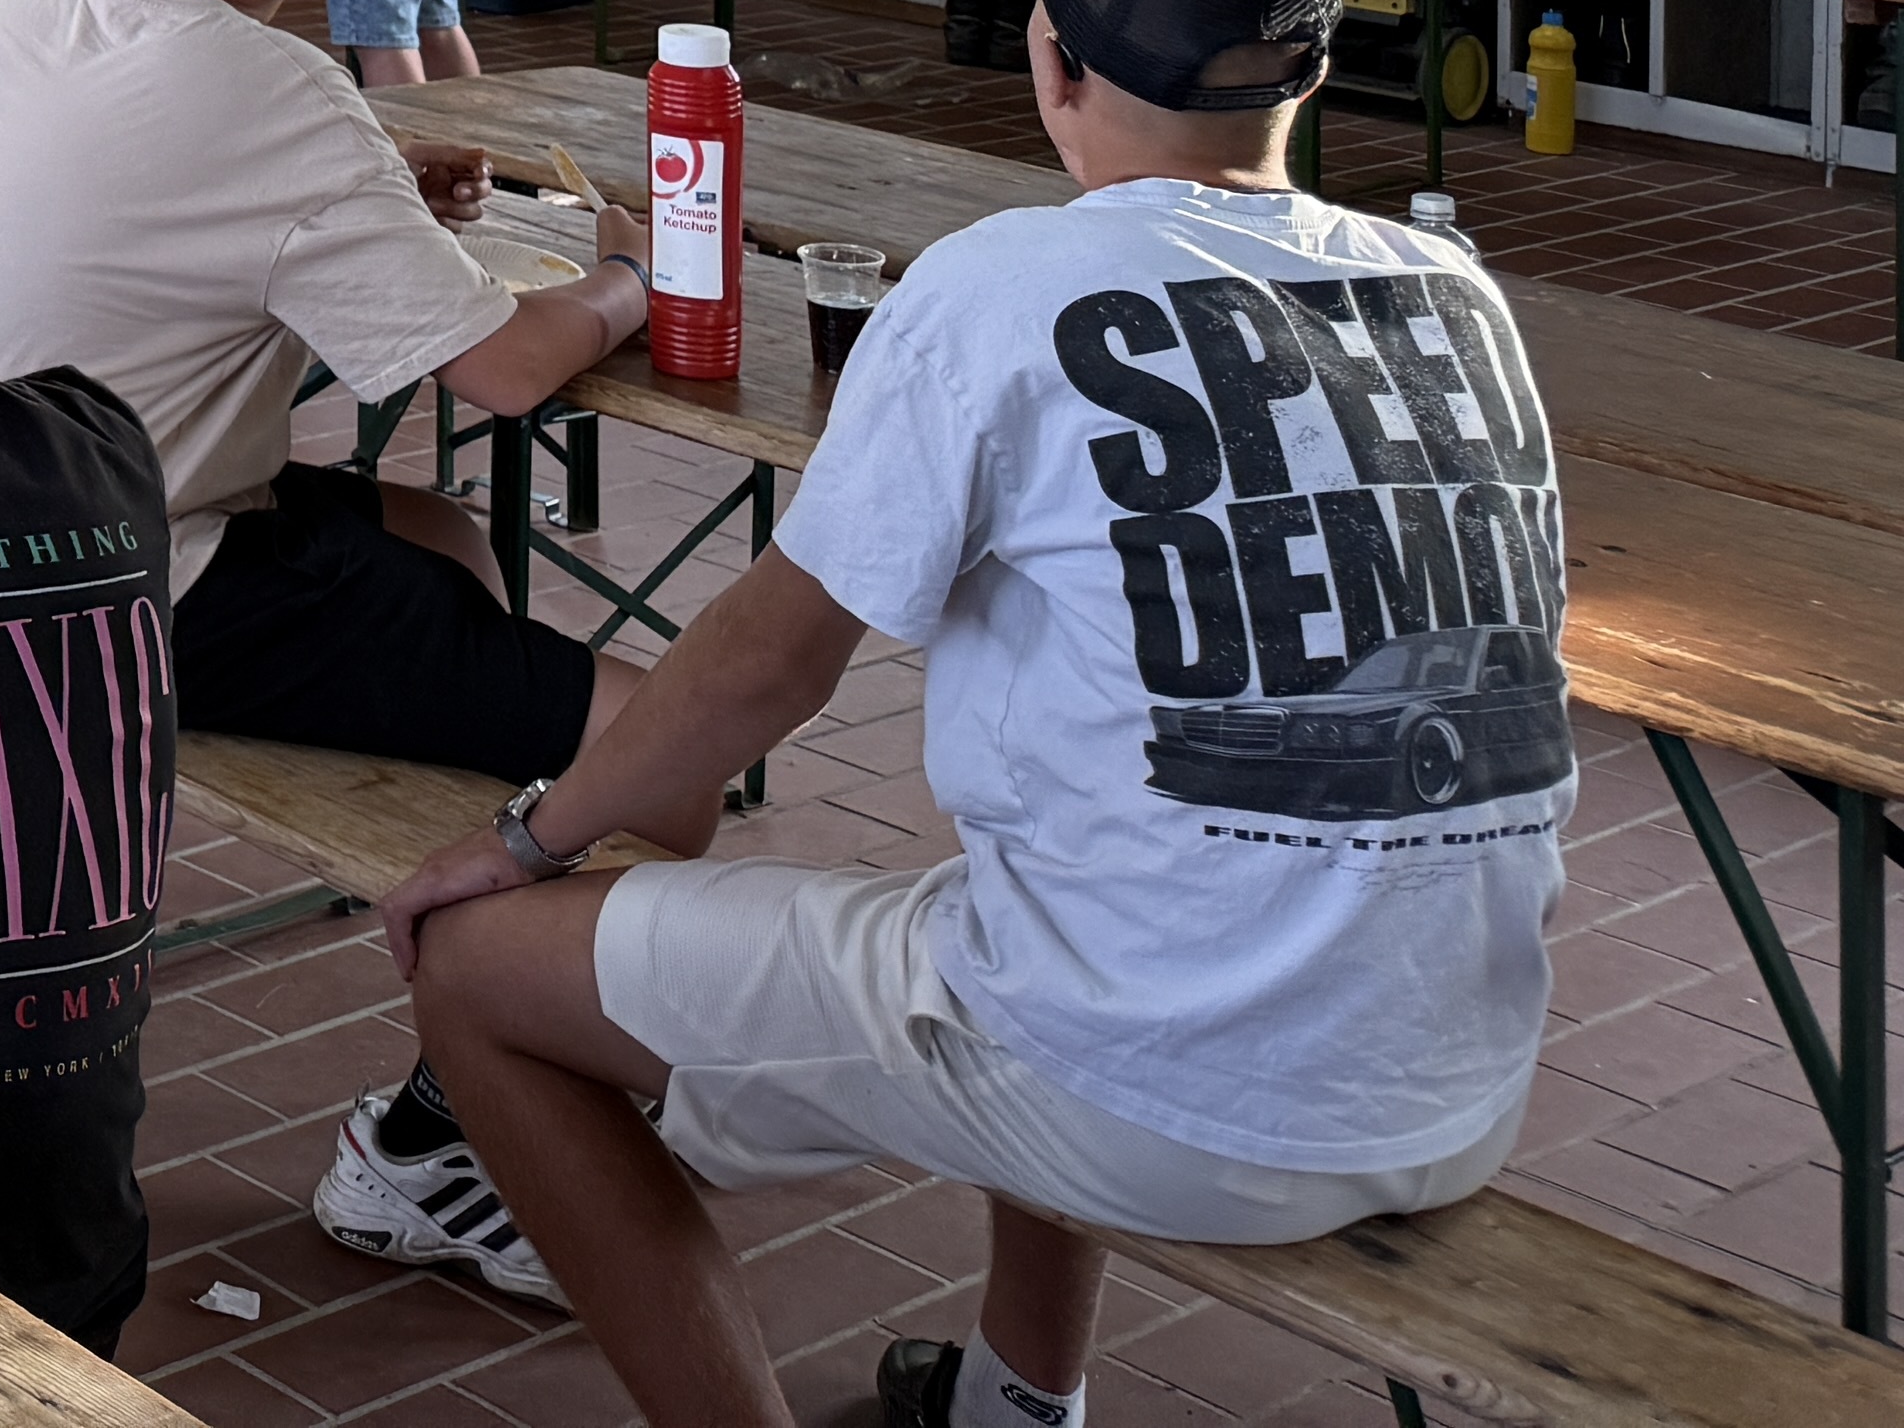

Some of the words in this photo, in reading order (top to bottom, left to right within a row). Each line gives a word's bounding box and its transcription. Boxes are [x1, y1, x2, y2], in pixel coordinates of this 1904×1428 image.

[669, 204, 717, 220] Tomato
[663, 215, 717, 234] Ketchup
[1052, 273, 1549, 514] SPEED
[1204, 824, 1331, 849] FUEL
[1343, 835, 1431, 851] THE
[43, 1055, 90, 1079] YORK
